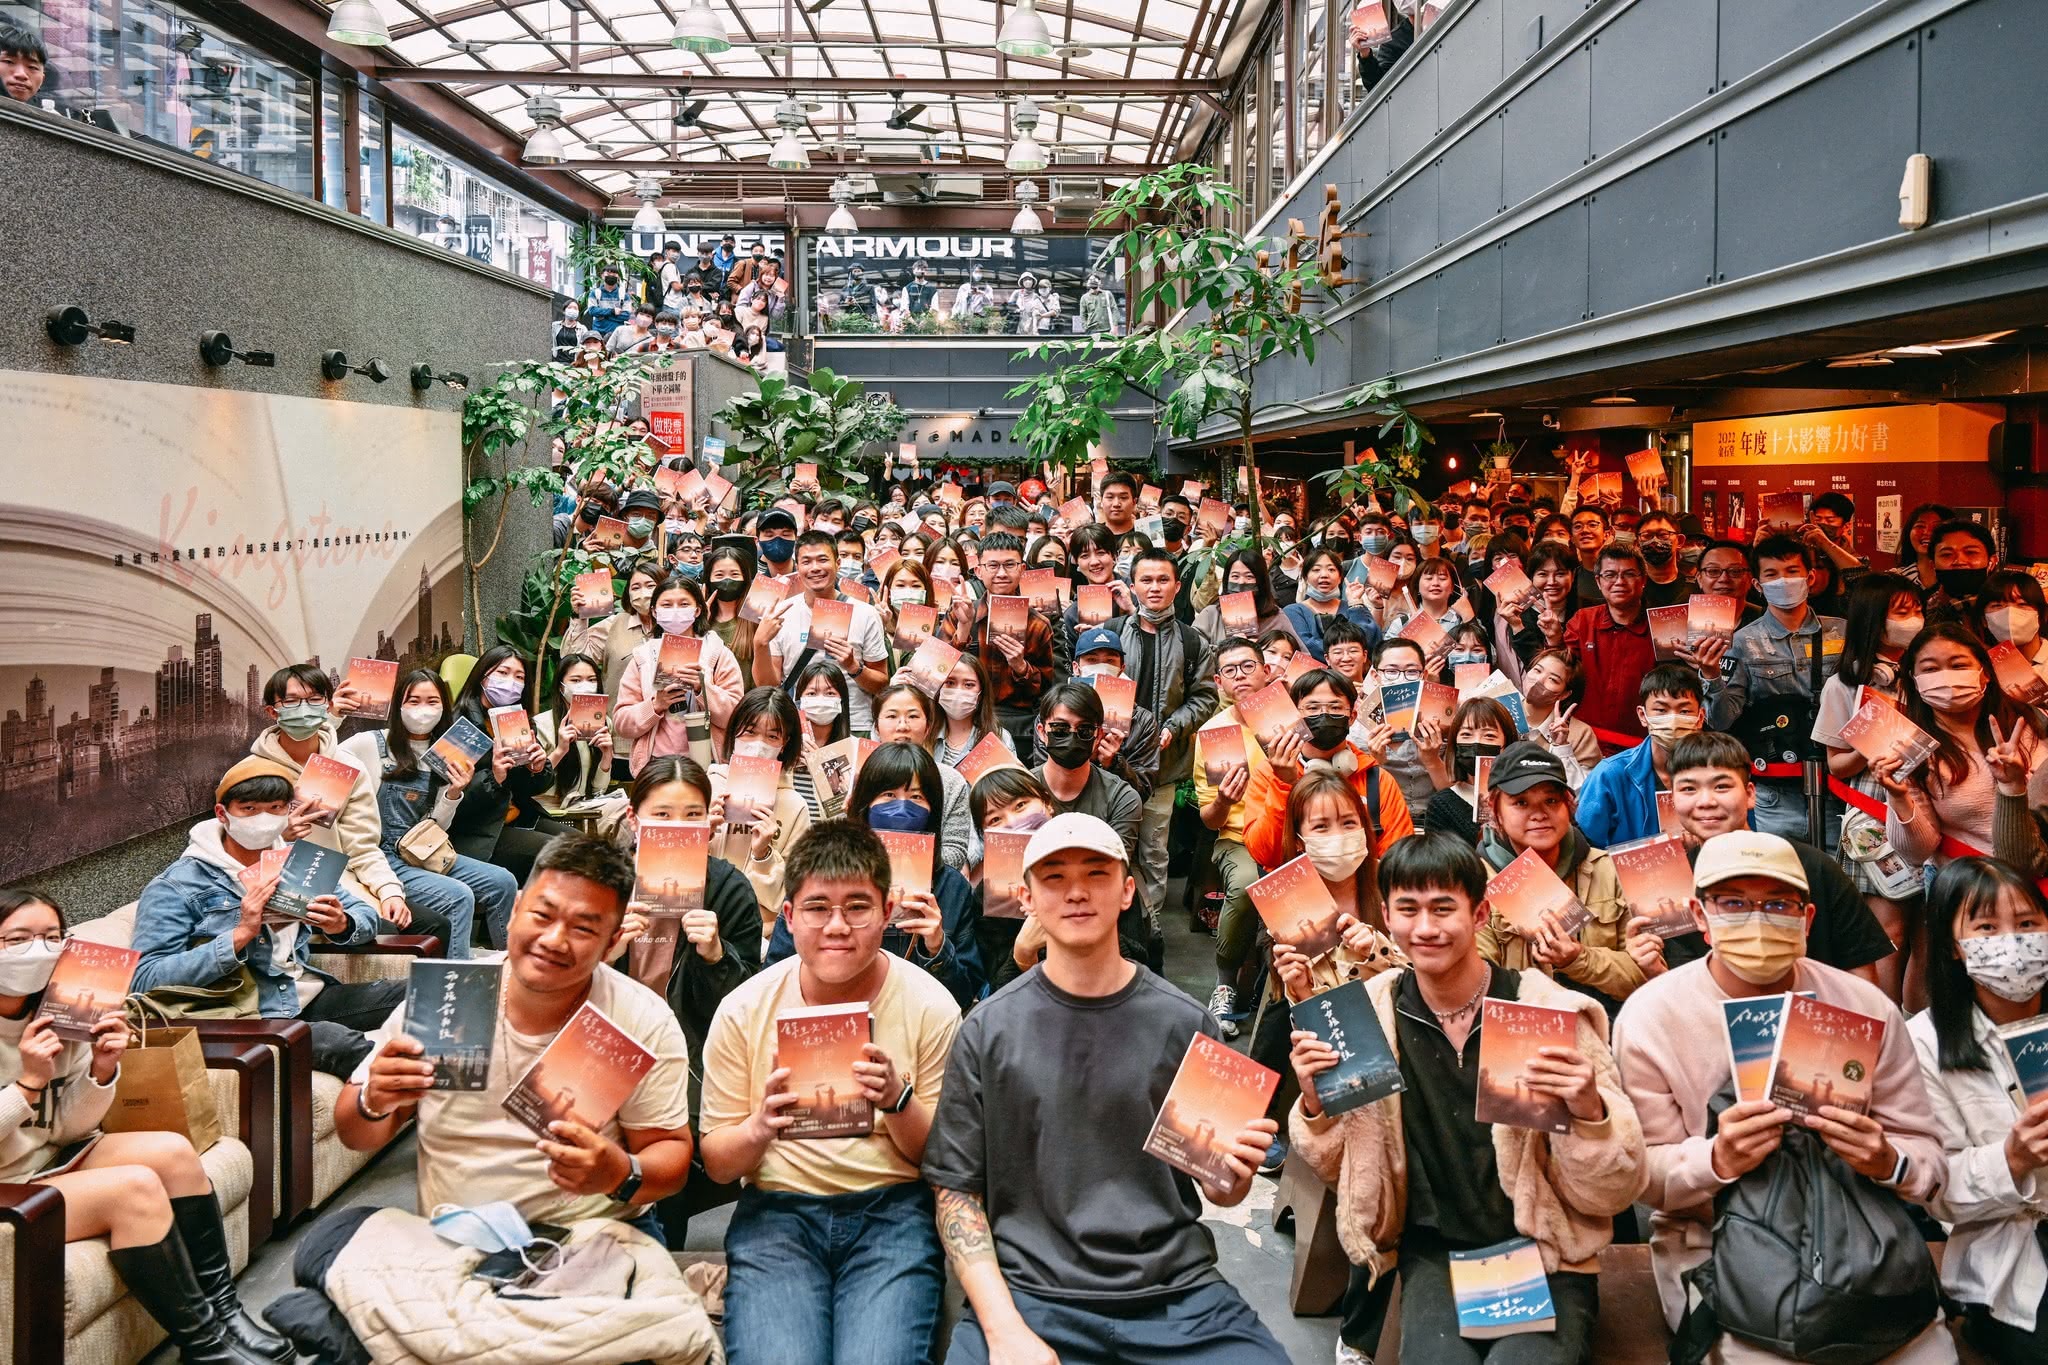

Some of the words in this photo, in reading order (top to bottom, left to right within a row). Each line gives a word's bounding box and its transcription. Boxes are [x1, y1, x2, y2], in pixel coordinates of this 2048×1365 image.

[816, 237, 1014, 258] ARMOUR
[1718, 432, 1736, 444] 2022
[1740, 422, 1889, 457] 年度十大影響力好書
